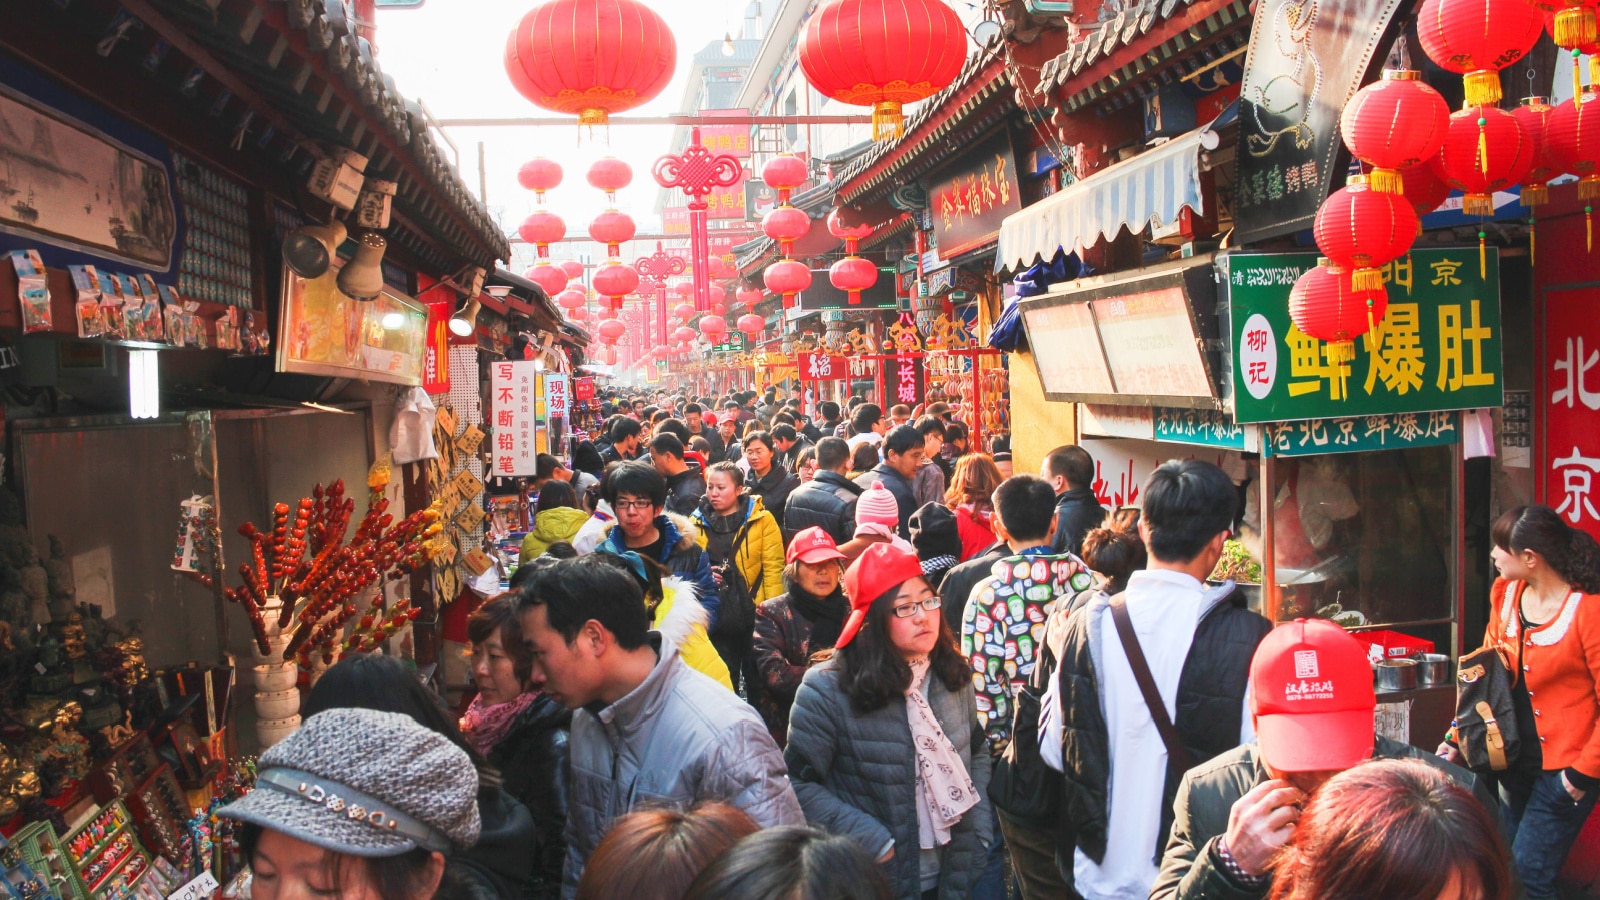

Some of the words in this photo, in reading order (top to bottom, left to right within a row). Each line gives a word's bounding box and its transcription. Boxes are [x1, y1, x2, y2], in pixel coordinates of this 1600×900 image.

[1247, 328, 1270, 385] 柳记
[1284, 299, 1495, 401] 鲜爆肚
[498, 363, 514, 474] 写不断铅笔
[1551, 335, 1600, 523] 北京
